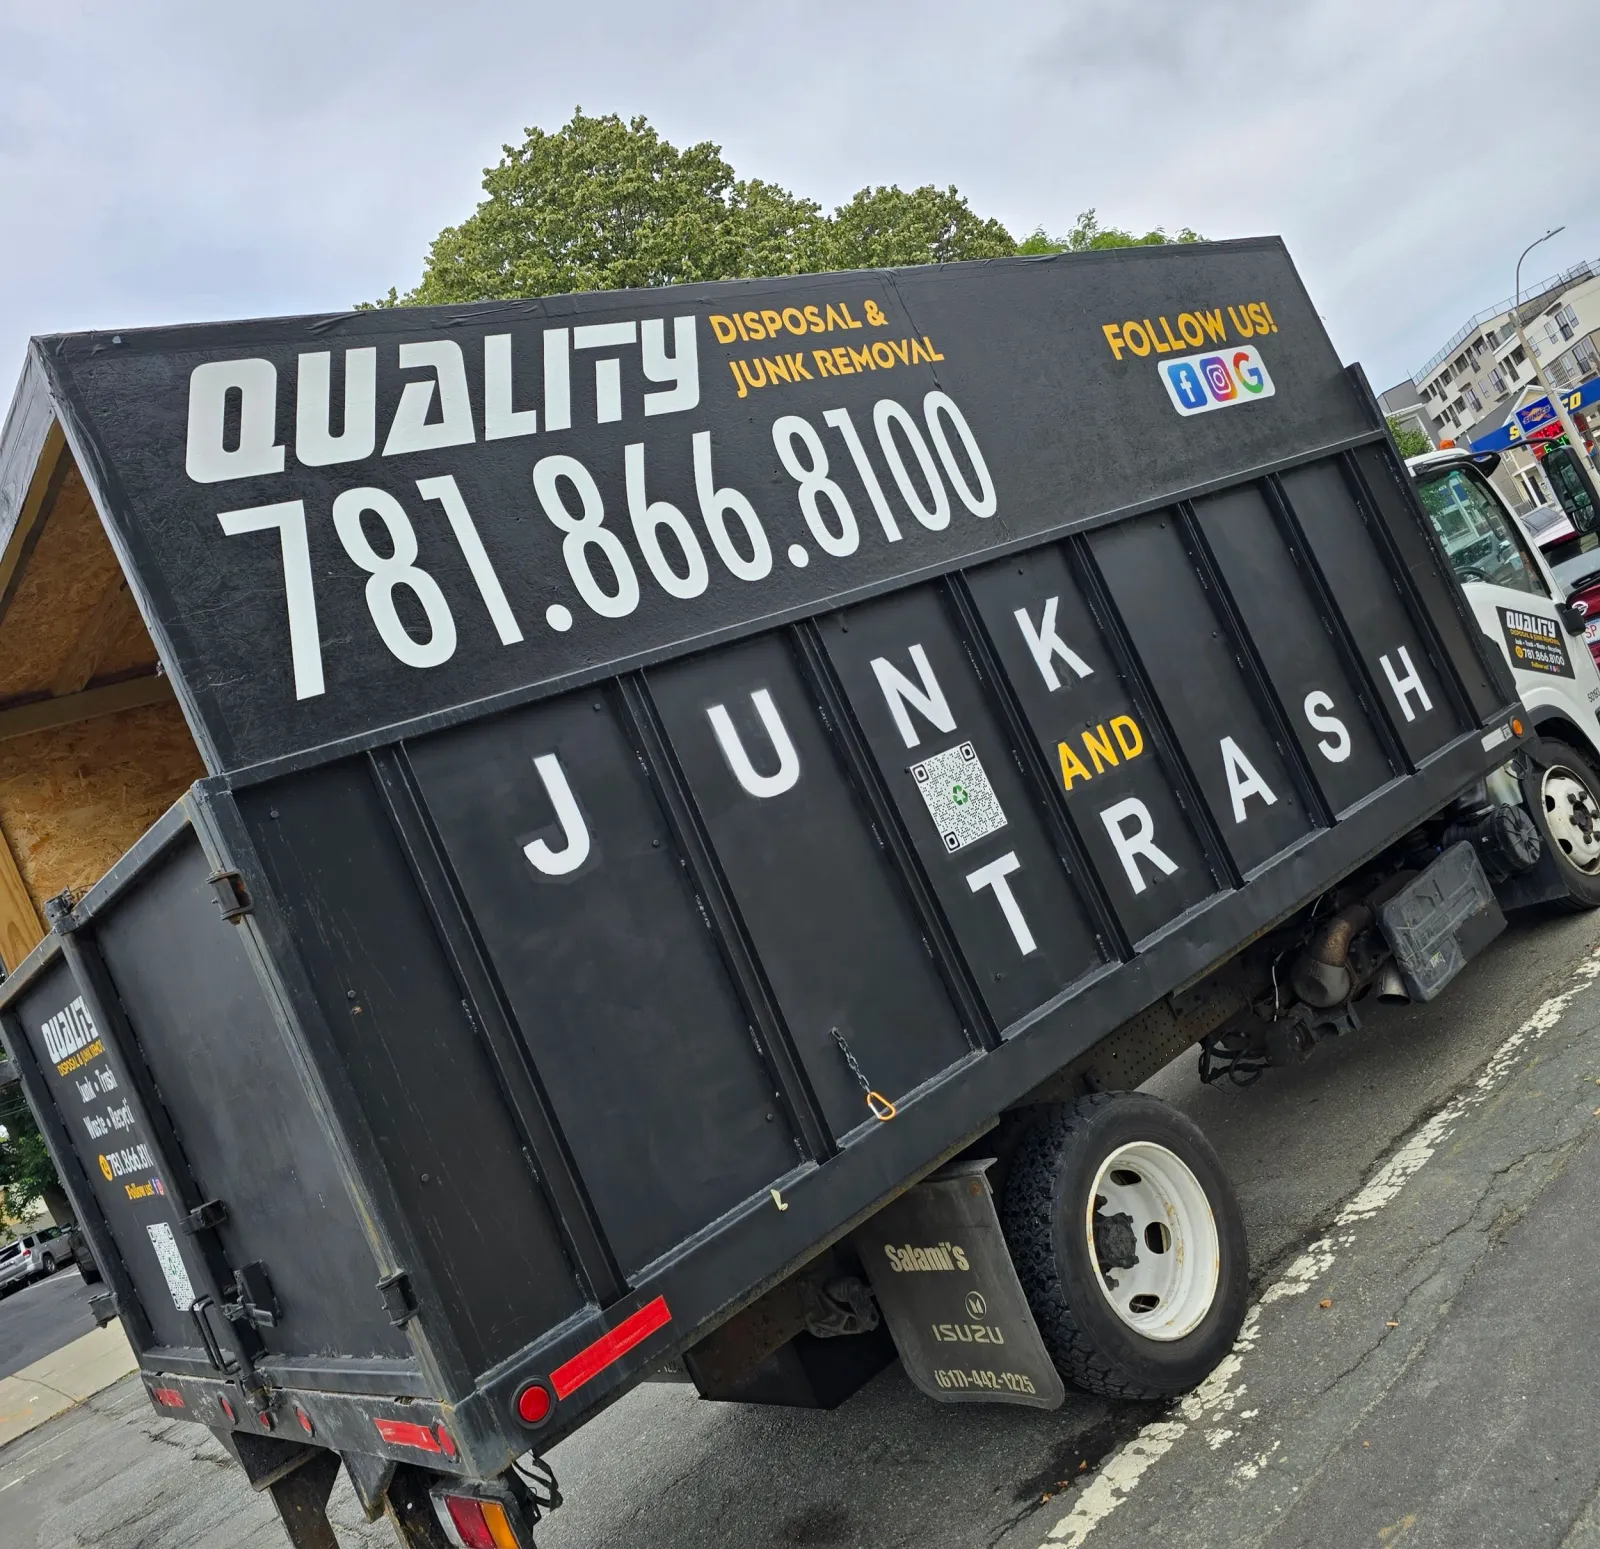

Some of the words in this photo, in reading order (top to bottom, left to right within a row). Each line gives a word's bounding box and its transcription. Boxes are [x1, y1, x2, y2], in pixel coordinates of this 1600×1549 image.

[709, 303, 862, 344] DISPOSAL
[864, 300, 889, 327] &
[1102, 308, 1227, 361] FOLLOW
[1227, 302, 1278, 338] US!
[729, 353, 814, 399] JUNK
[812, 336, 945, 378] REMOVAL
[186, 316, 700, 483] QUALITY
[1523, 405, 1551, 424] SUNOCO
[217, 391, 997, 700] 781.866.8100
[1506, 611, 1556, 638] QUALITY
[1057, 715, 1144, 791] AND
[41, 995, 99, 1064] QUALITY
[82, 1115, 109, 1140] Waste
[884, 1242, 970, 1272] Salami's
[932, 1325, 1004, 1344] ISUZU
[934, 1370, 1036, 1394] (617)-442-1225
